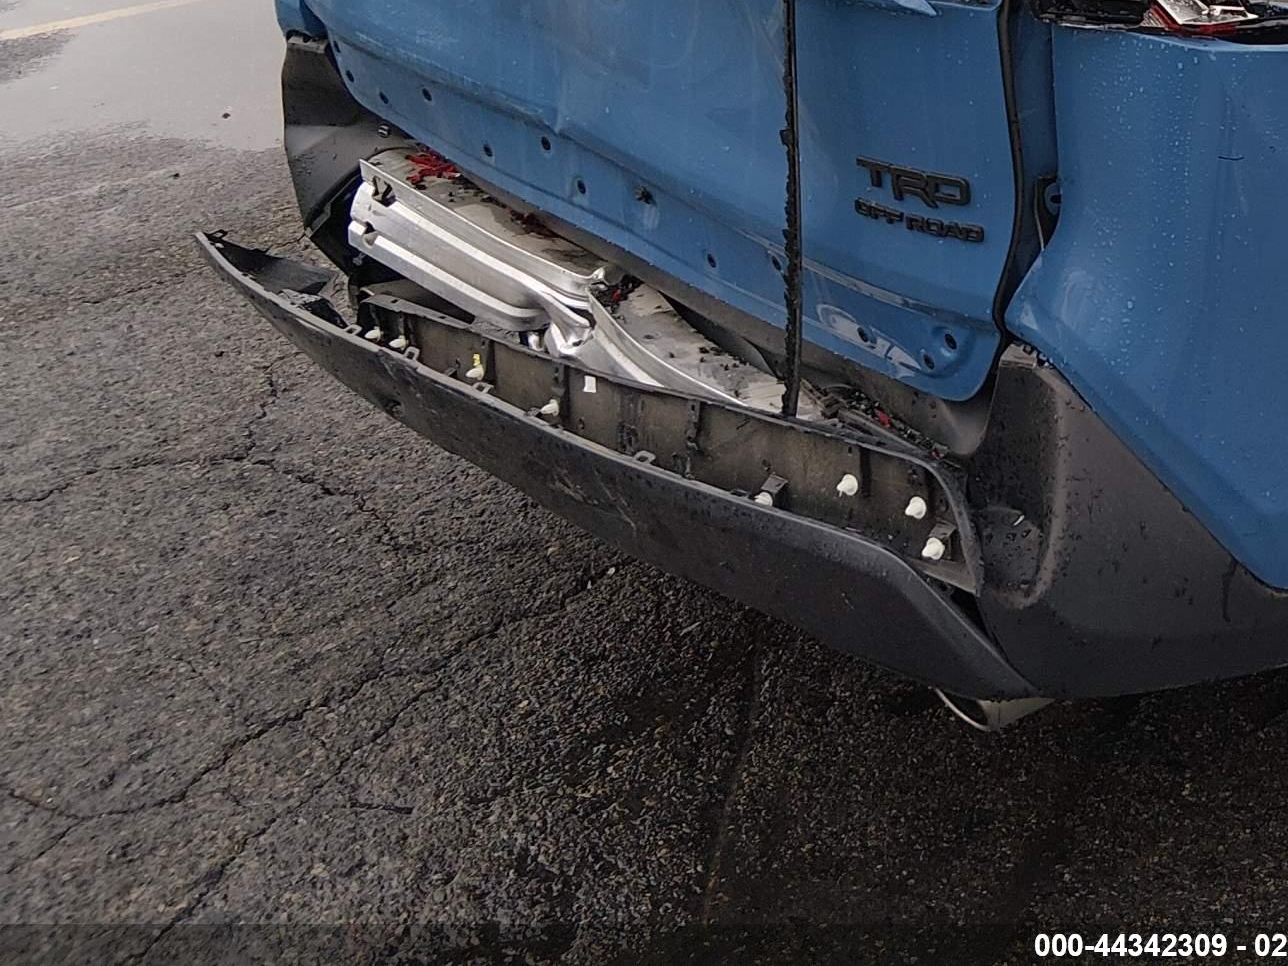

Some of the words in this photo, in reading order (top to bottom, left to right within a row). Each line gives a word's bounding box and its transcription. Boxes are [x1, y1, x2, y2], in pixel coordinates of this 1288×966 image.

[855, 155, 971, 209] TRD
[854, 197, 904, 224] OFF
[905, 212, 985, 243] ROAD
